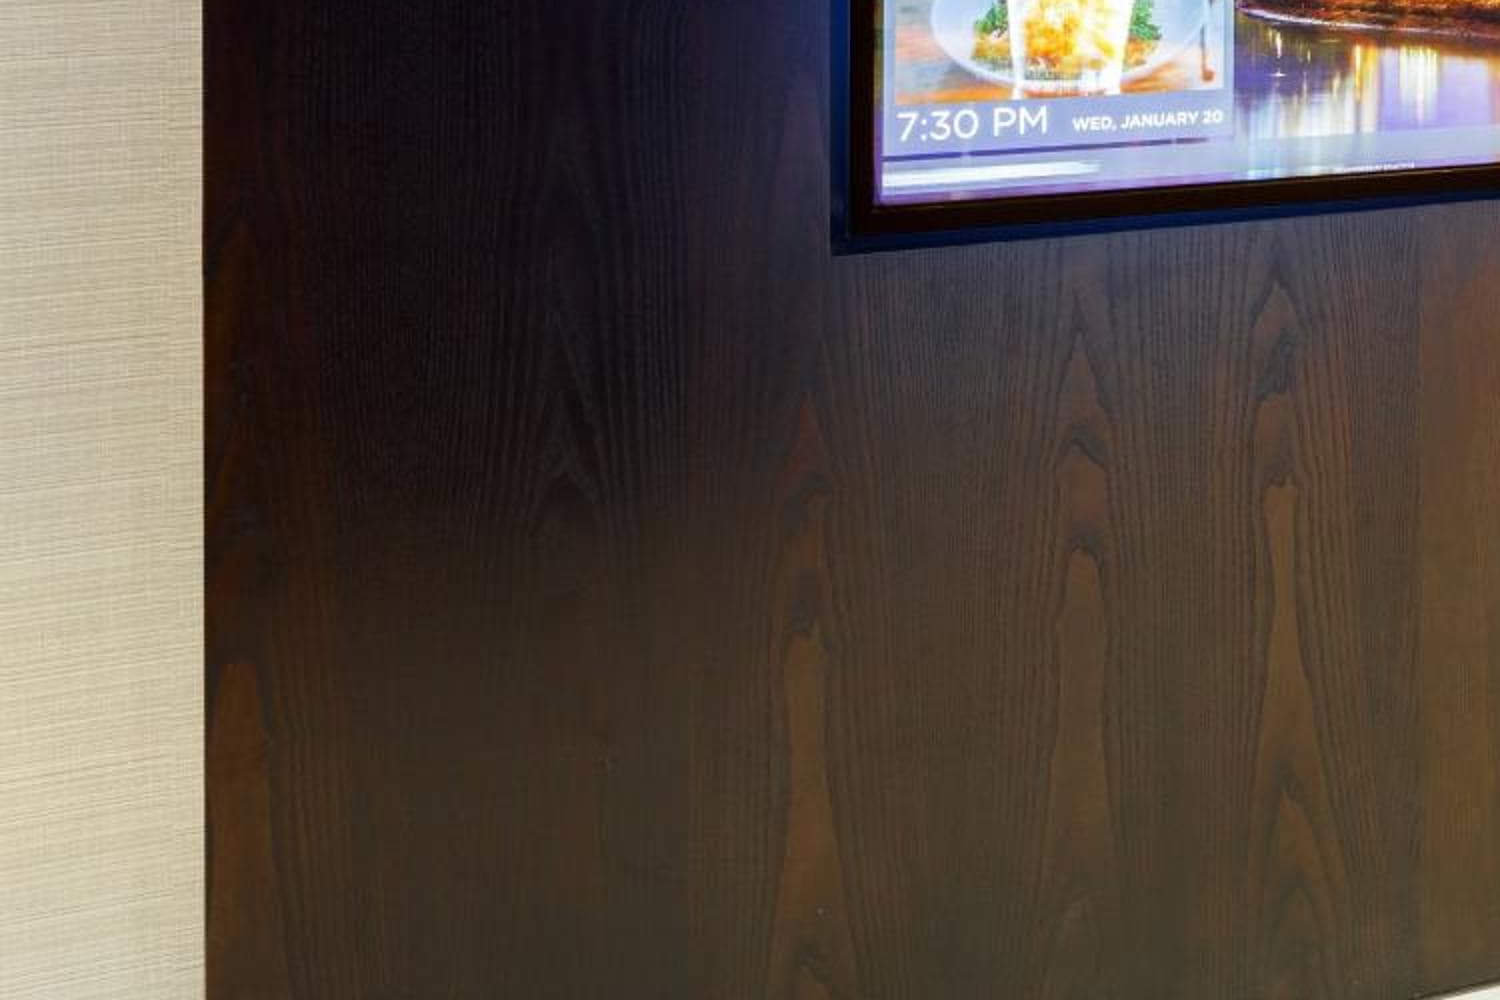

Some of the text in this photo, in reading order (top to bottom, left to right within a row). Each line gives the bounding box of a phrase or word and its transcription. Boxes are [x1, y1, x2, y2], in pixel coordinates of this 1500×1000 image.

[896, 105, 1048, 142] 7:30 PM
[1120, 112, 1198, 130] JANUARY
[1202, 109, 1224, 125] 20
